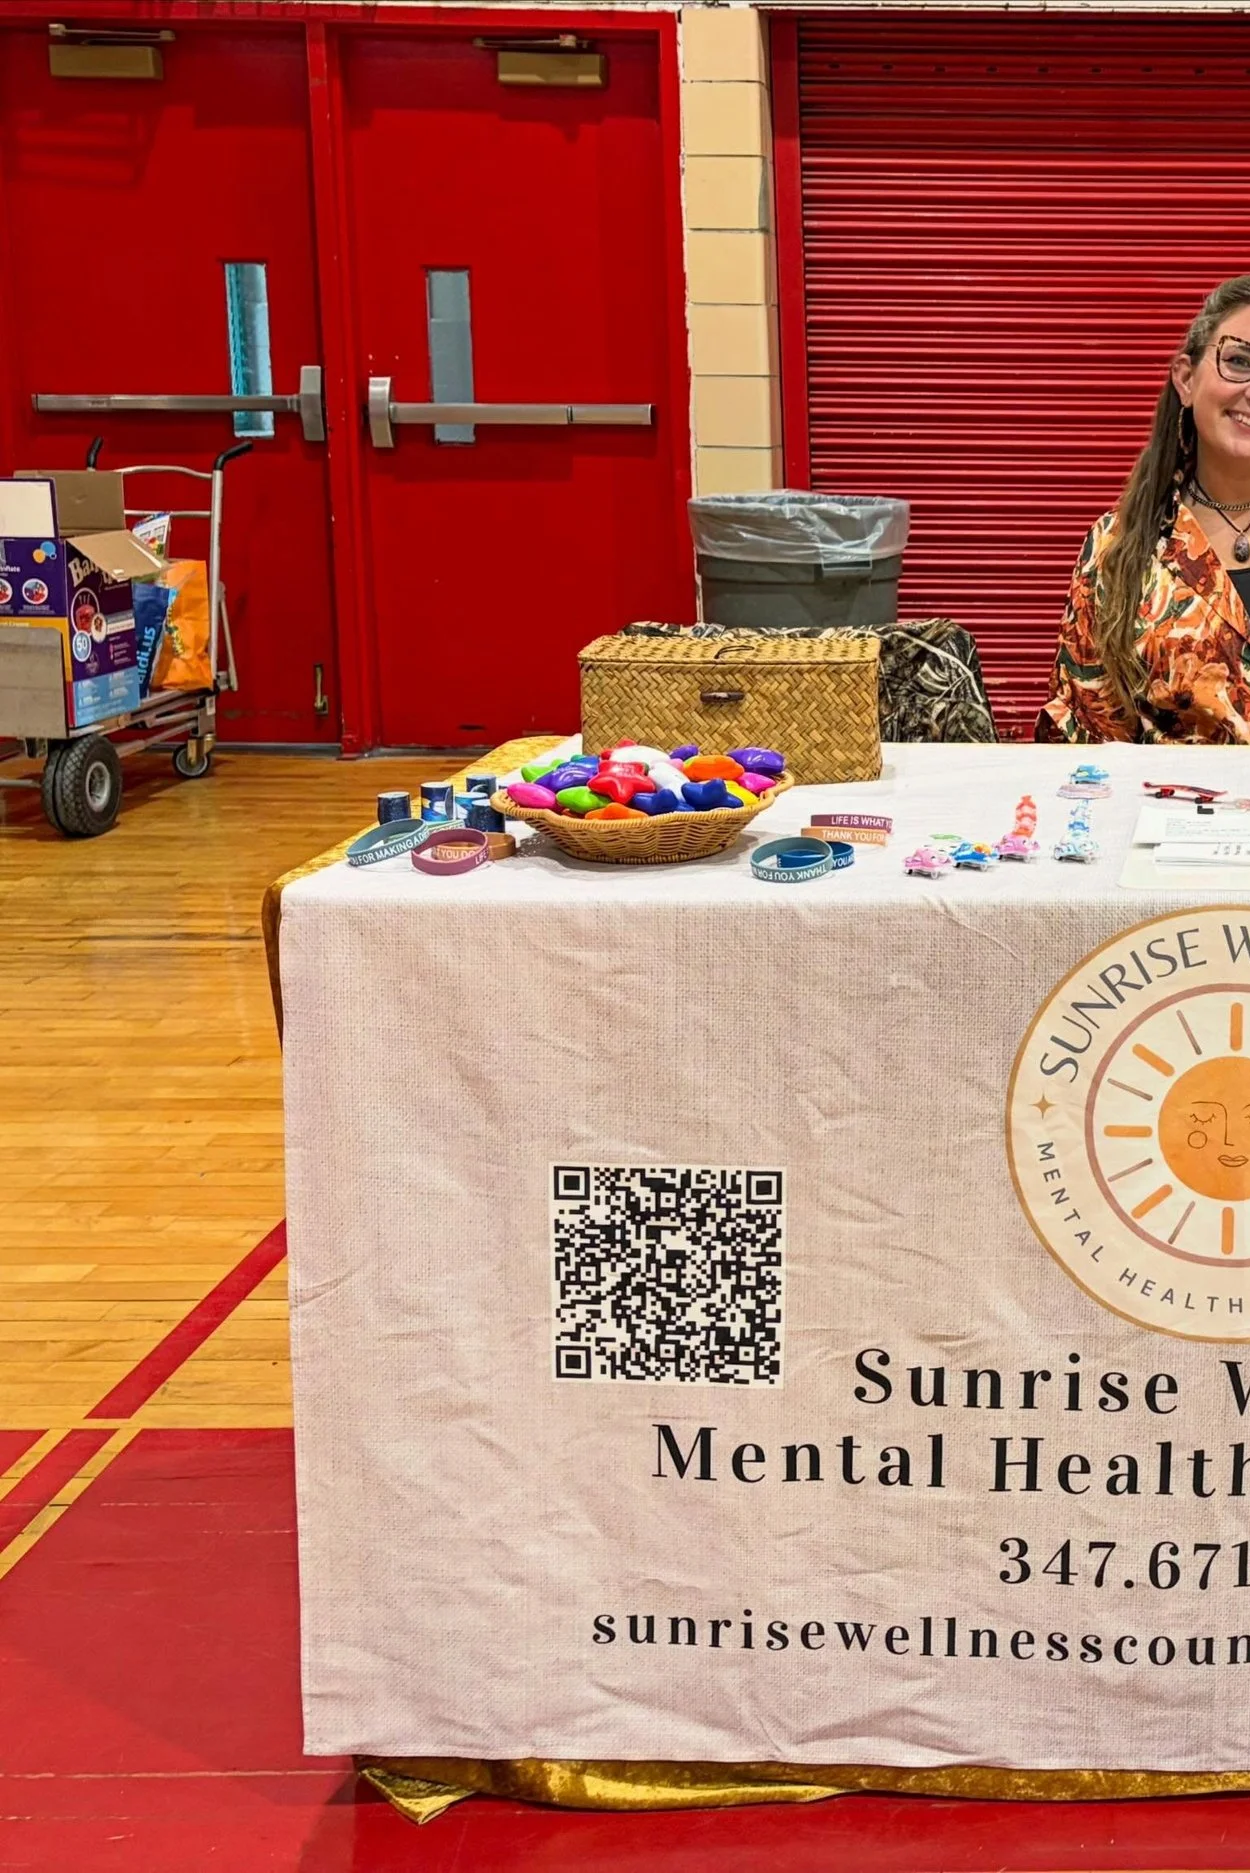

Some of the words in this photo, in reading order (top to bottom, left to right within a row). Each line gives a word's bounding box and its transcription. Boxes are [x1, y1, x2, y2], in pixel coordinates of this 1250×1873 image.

[831, 816, 849, 825] LIFE
[850, 816, 859, 825] IS
[861, 817, 885, 827] WHAT
[822, 829, 851, 840] THANK
[854, 831, 871, 841] YOU
[872, 833, 886, 843] FOR
[358, 852, 375, 865] FOR
[376, 839, 414, 859] MAKING
[413, 835, 420, 846] A
[441, 848, 459, 859] YOU
[832, 858, 849, 869] YOU
[758, 870, 773, 880] FOR
[774, 872, 795, 882] YOU
[797, 864, 827, 880] THANK
[1039, 928, 1208, 1083] SUNRISE
[1037, 1140, 1106, 1263] MENTAL
[1119, 1266, 1244, 1313] HEALTH
[854, 1348, 1180, 1415] Sunrise
[652, 1423, 946, 1489] Mental
